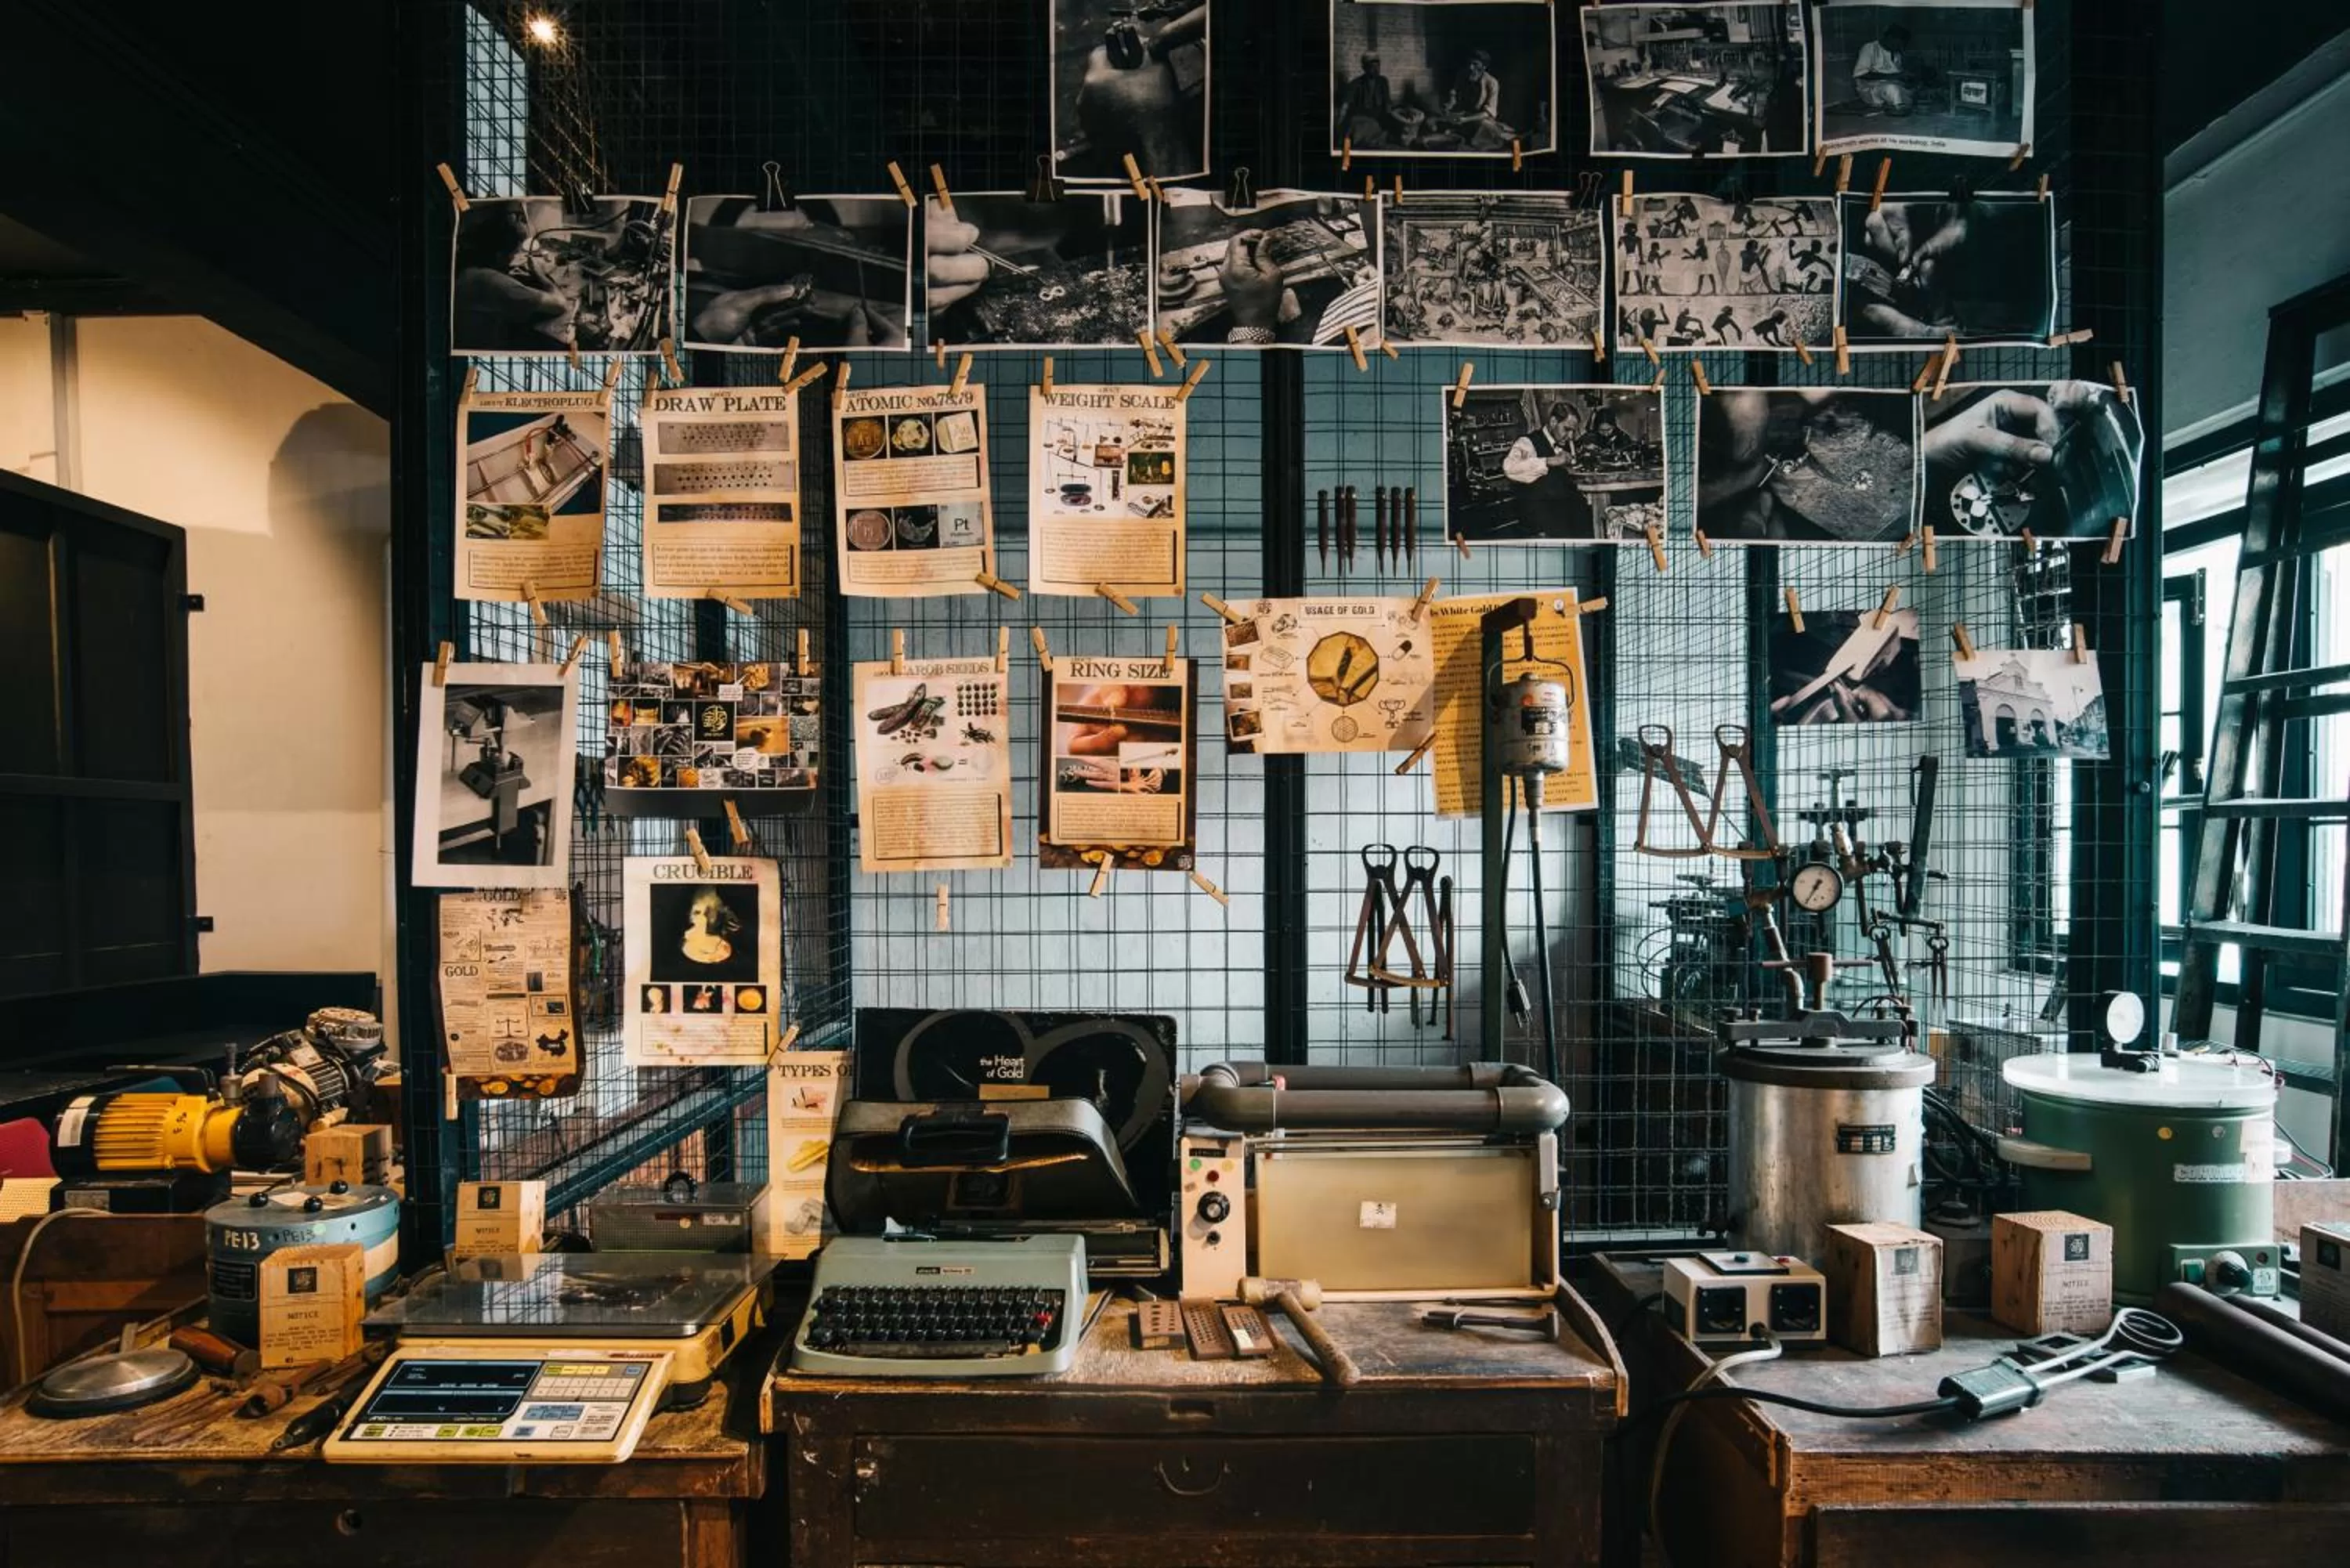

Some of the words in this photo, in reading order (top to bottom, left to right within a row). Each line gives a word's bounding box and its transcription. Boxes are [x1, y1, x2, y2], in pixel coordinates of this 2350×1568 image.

[655, 397, 715, 411] DRAW
[724, 396, 786, 411] PLATE
[845, 395, 913, 412] ATOMIC
[1043, 392, 1115, 408] WEIGHT
[1119, 394, 1176, 409] SCALE
[954, 518, 970, 531] Pt
[1305, 605, 1334, 615] USAGE
[1337, 605, 1347, 615] OF
[1352, 605, 1375, 615] GOLD
[1441, 607, 1468, 616] White
[945, 662, 989, 674] SEEDS
[1070, 662, 1121, 677] RING
[1127, 663, 1170, 679] SIZE
[483, 890, 521, 902] GOLD
[445, 965, 479, 977] GOLD
[980, 1057, 992, 1066] the
[994, 1055, 1025, 1067] Heart
[778, 1064, 831, 1078] TYPES
[986, 1068, 995, 1078] of
[997, 1066, 1024, 1078] Gold
[225, 1229, 260, 1250] PE13
[287, 1310, 320, 1320] NOTICE
